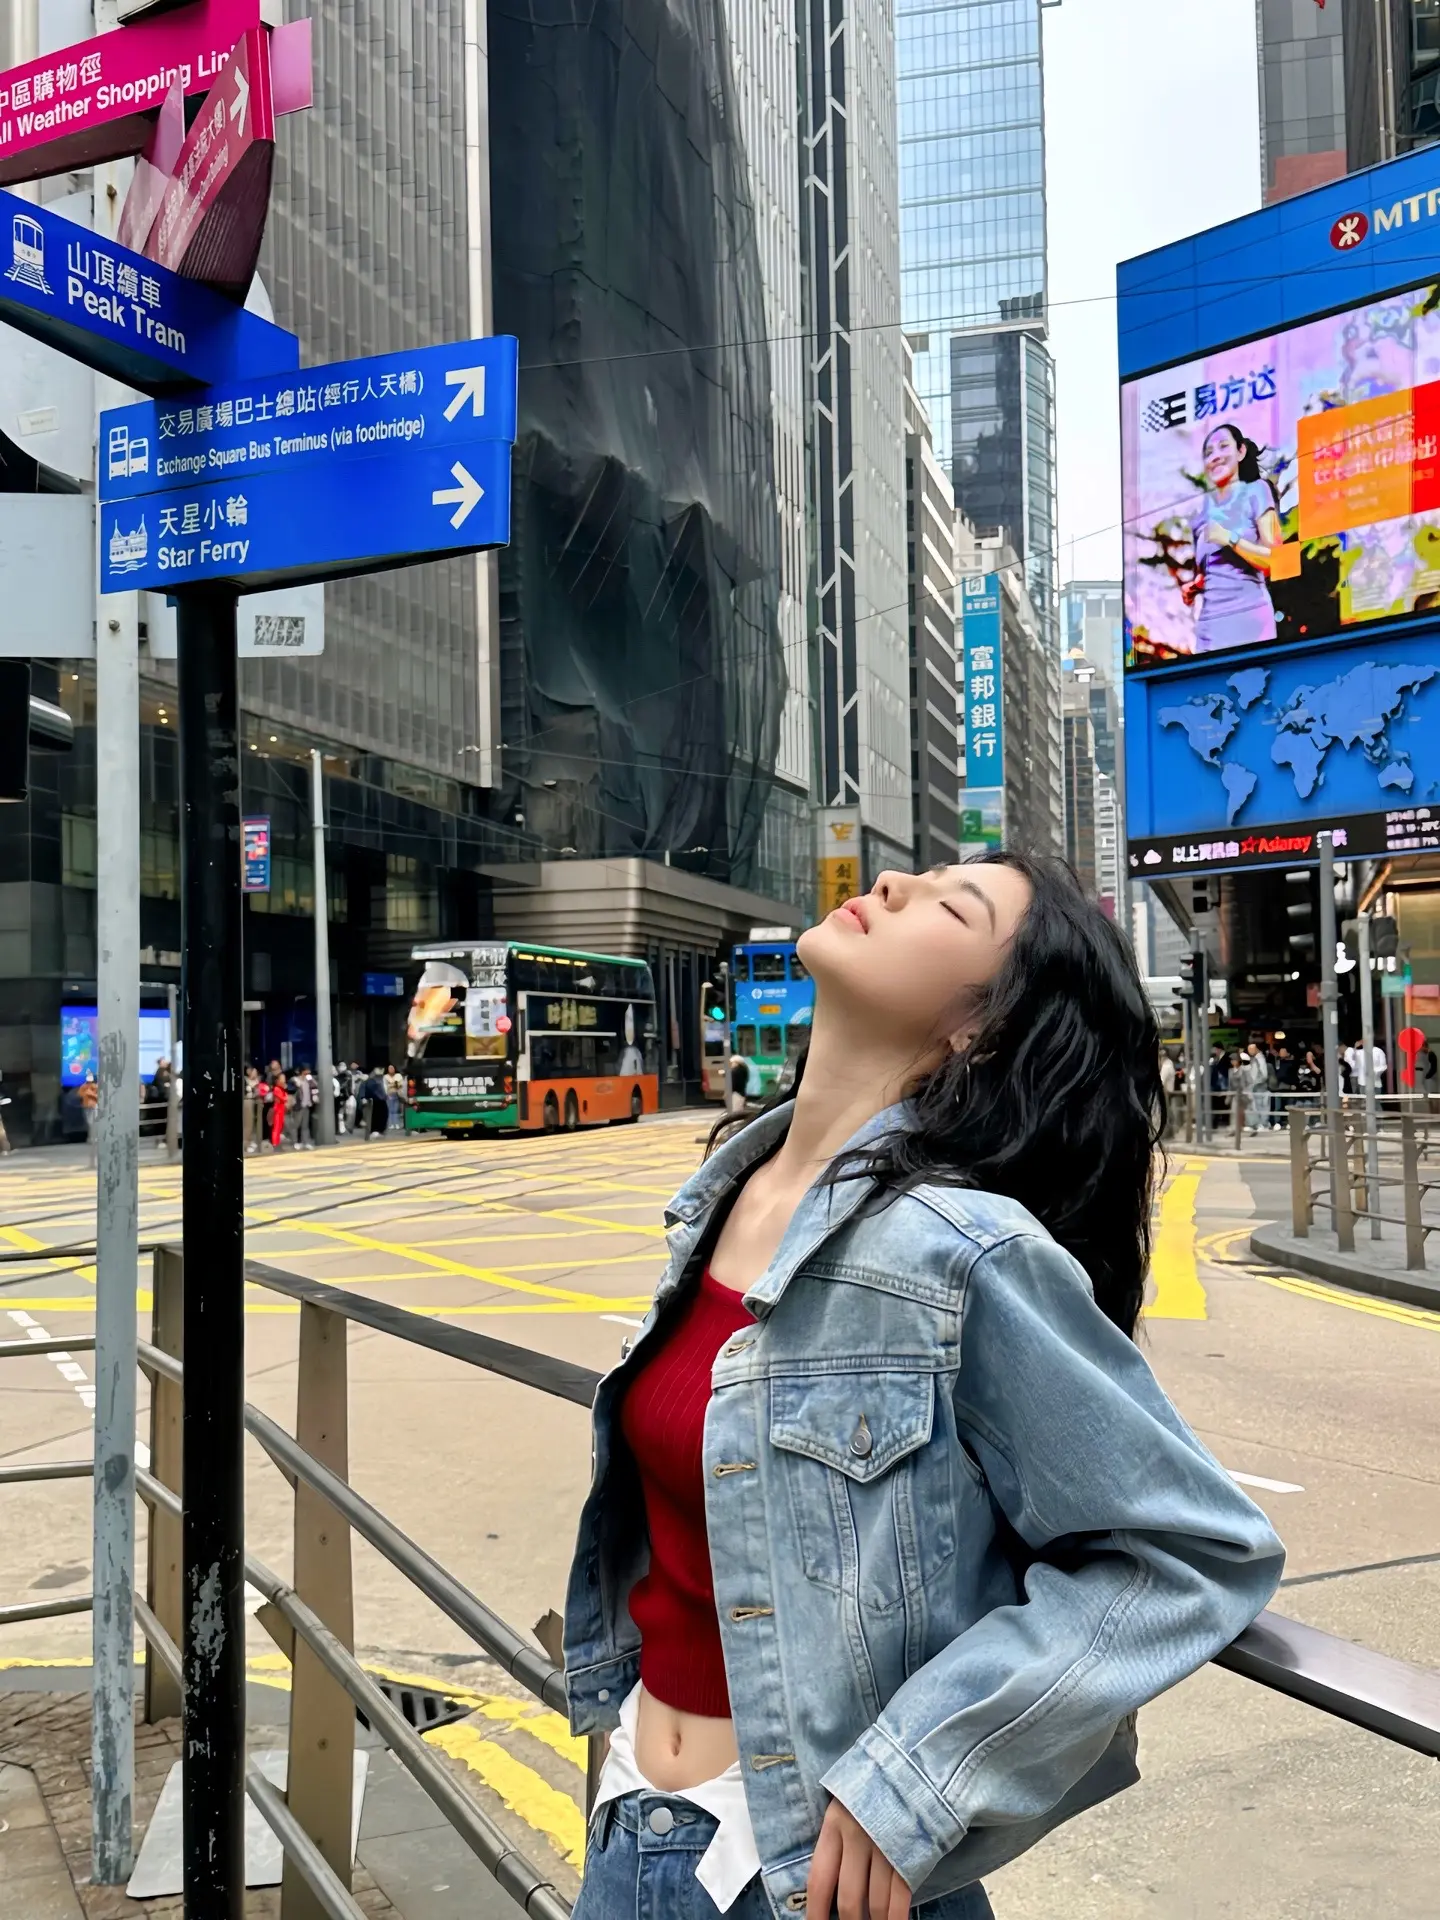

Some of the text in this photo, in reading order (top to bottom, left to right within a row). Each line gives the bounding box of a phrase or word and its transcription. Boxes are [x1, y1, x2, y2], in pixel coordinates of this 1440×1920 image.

[0, 45, 235, 145] ll Weather Shopping Lin
[68, 241, 161, 308] 山頂纜車
[68, 275, 185, 354] Peak Tram
[1194, 365, 1276, 420] 易方达
[157, 414, 425, 476] Exchange Square Bus Terminus (via footbridge)
[159, 494, 248, 538] 天星小輪
[158, 539, 249, 570] Star Ferry
[971, 646, 996, 757] 富邦銀行
[1258, 835, 1312, 854] Asiaray
